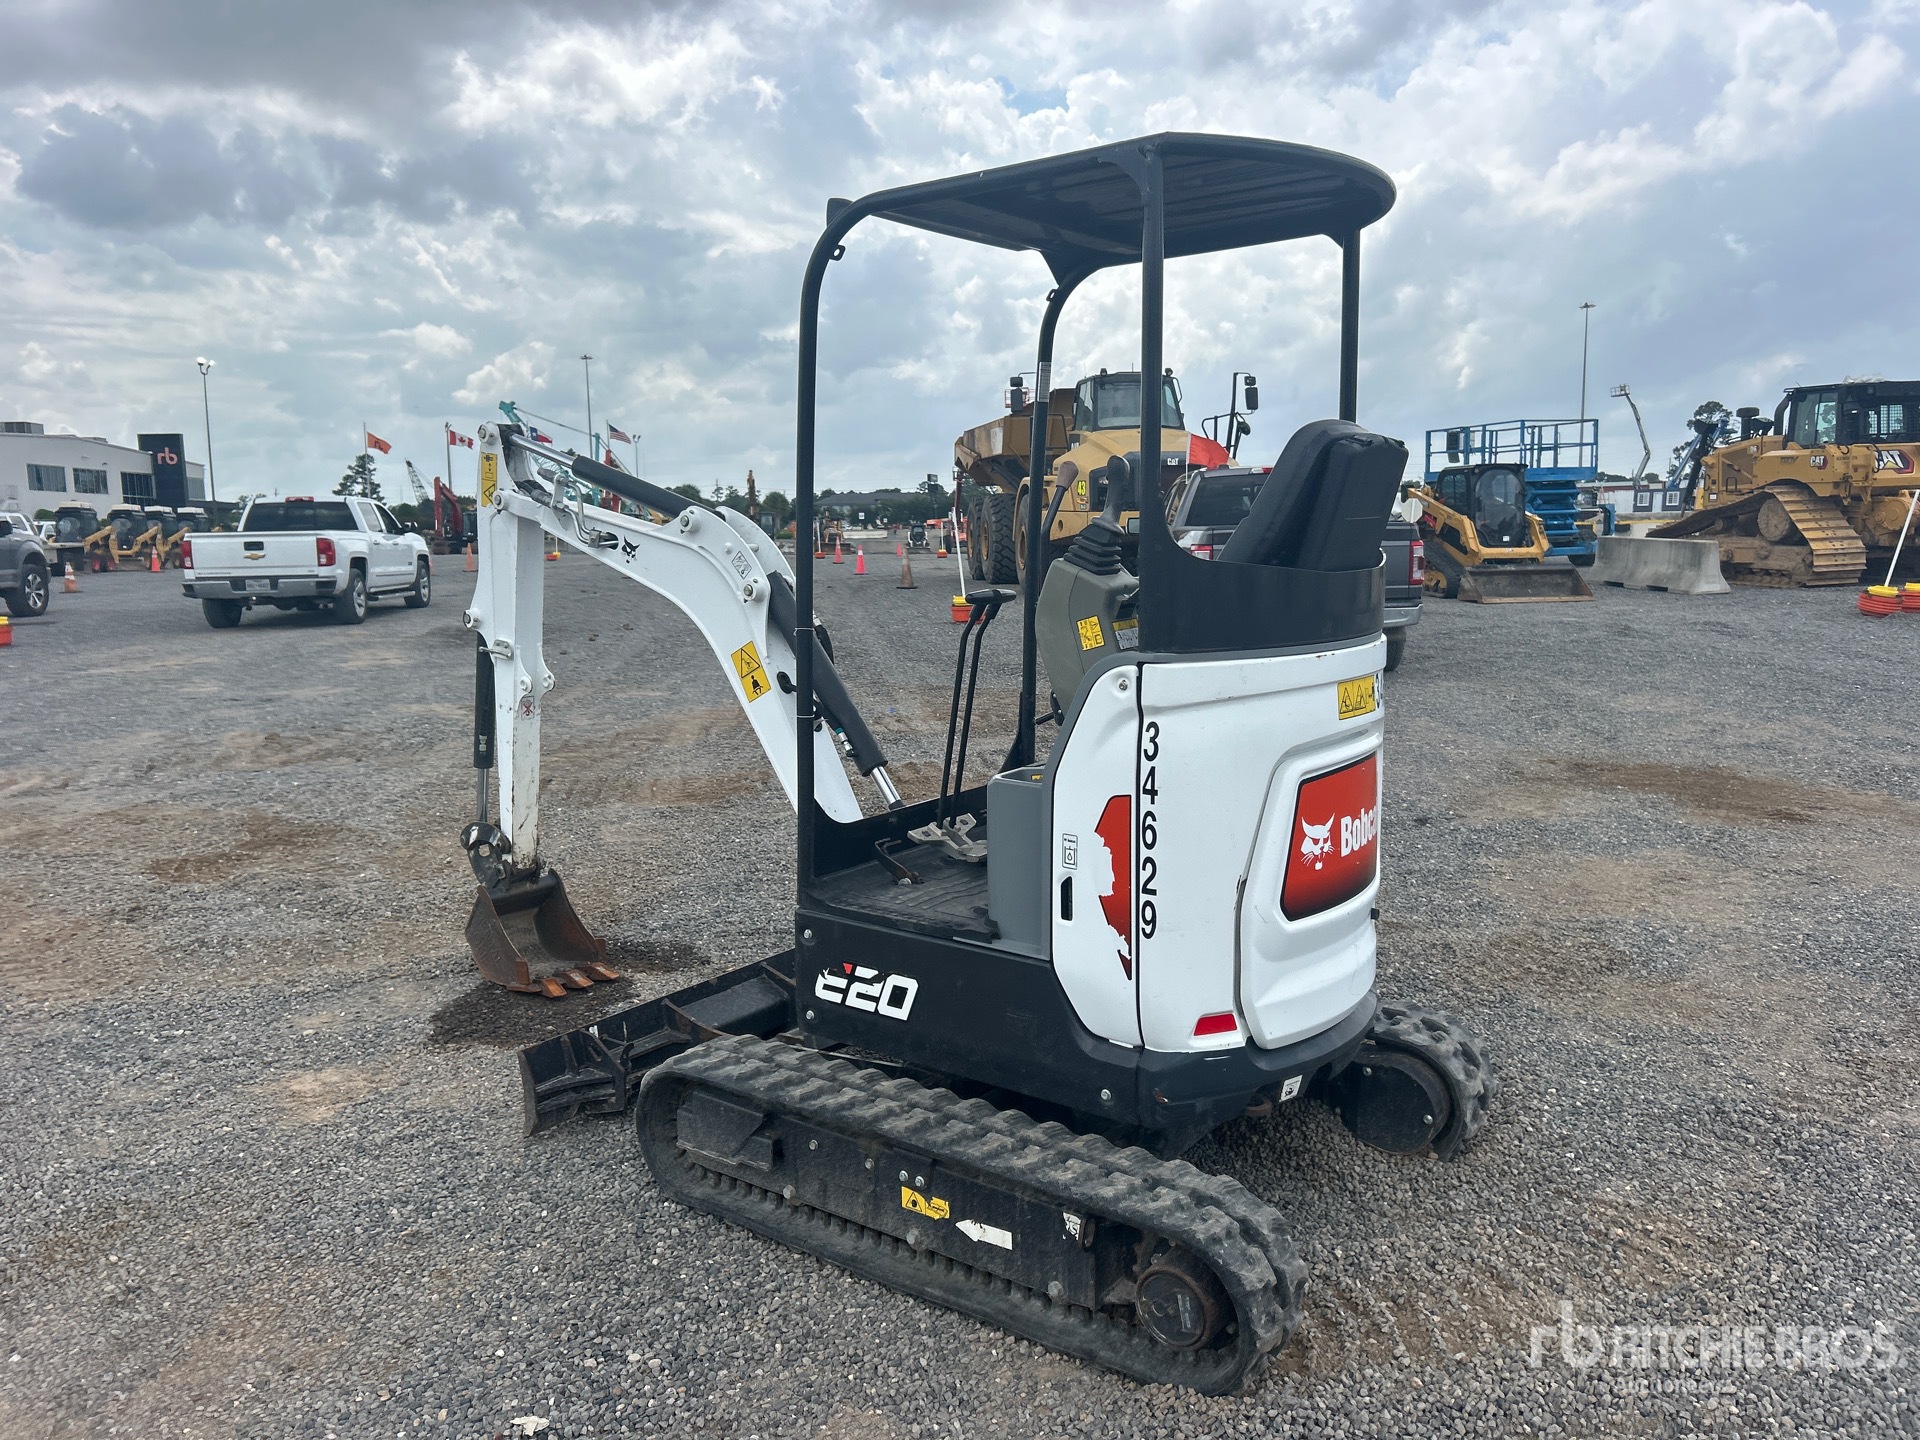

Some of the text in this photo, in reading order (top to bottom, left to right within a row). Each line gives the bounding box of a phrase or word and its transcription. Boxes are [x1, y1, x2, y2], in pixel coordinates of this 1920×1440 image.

[157, 447, 178, 465] rb
[1167, 458, 1179, 466] CAT
[1810, 455, 1825, 468] CAT
[1077, 481, 1087, 496] 43
[1141, 721, 1160, 940] 34629
[815, 962, 919, 1021] E20
